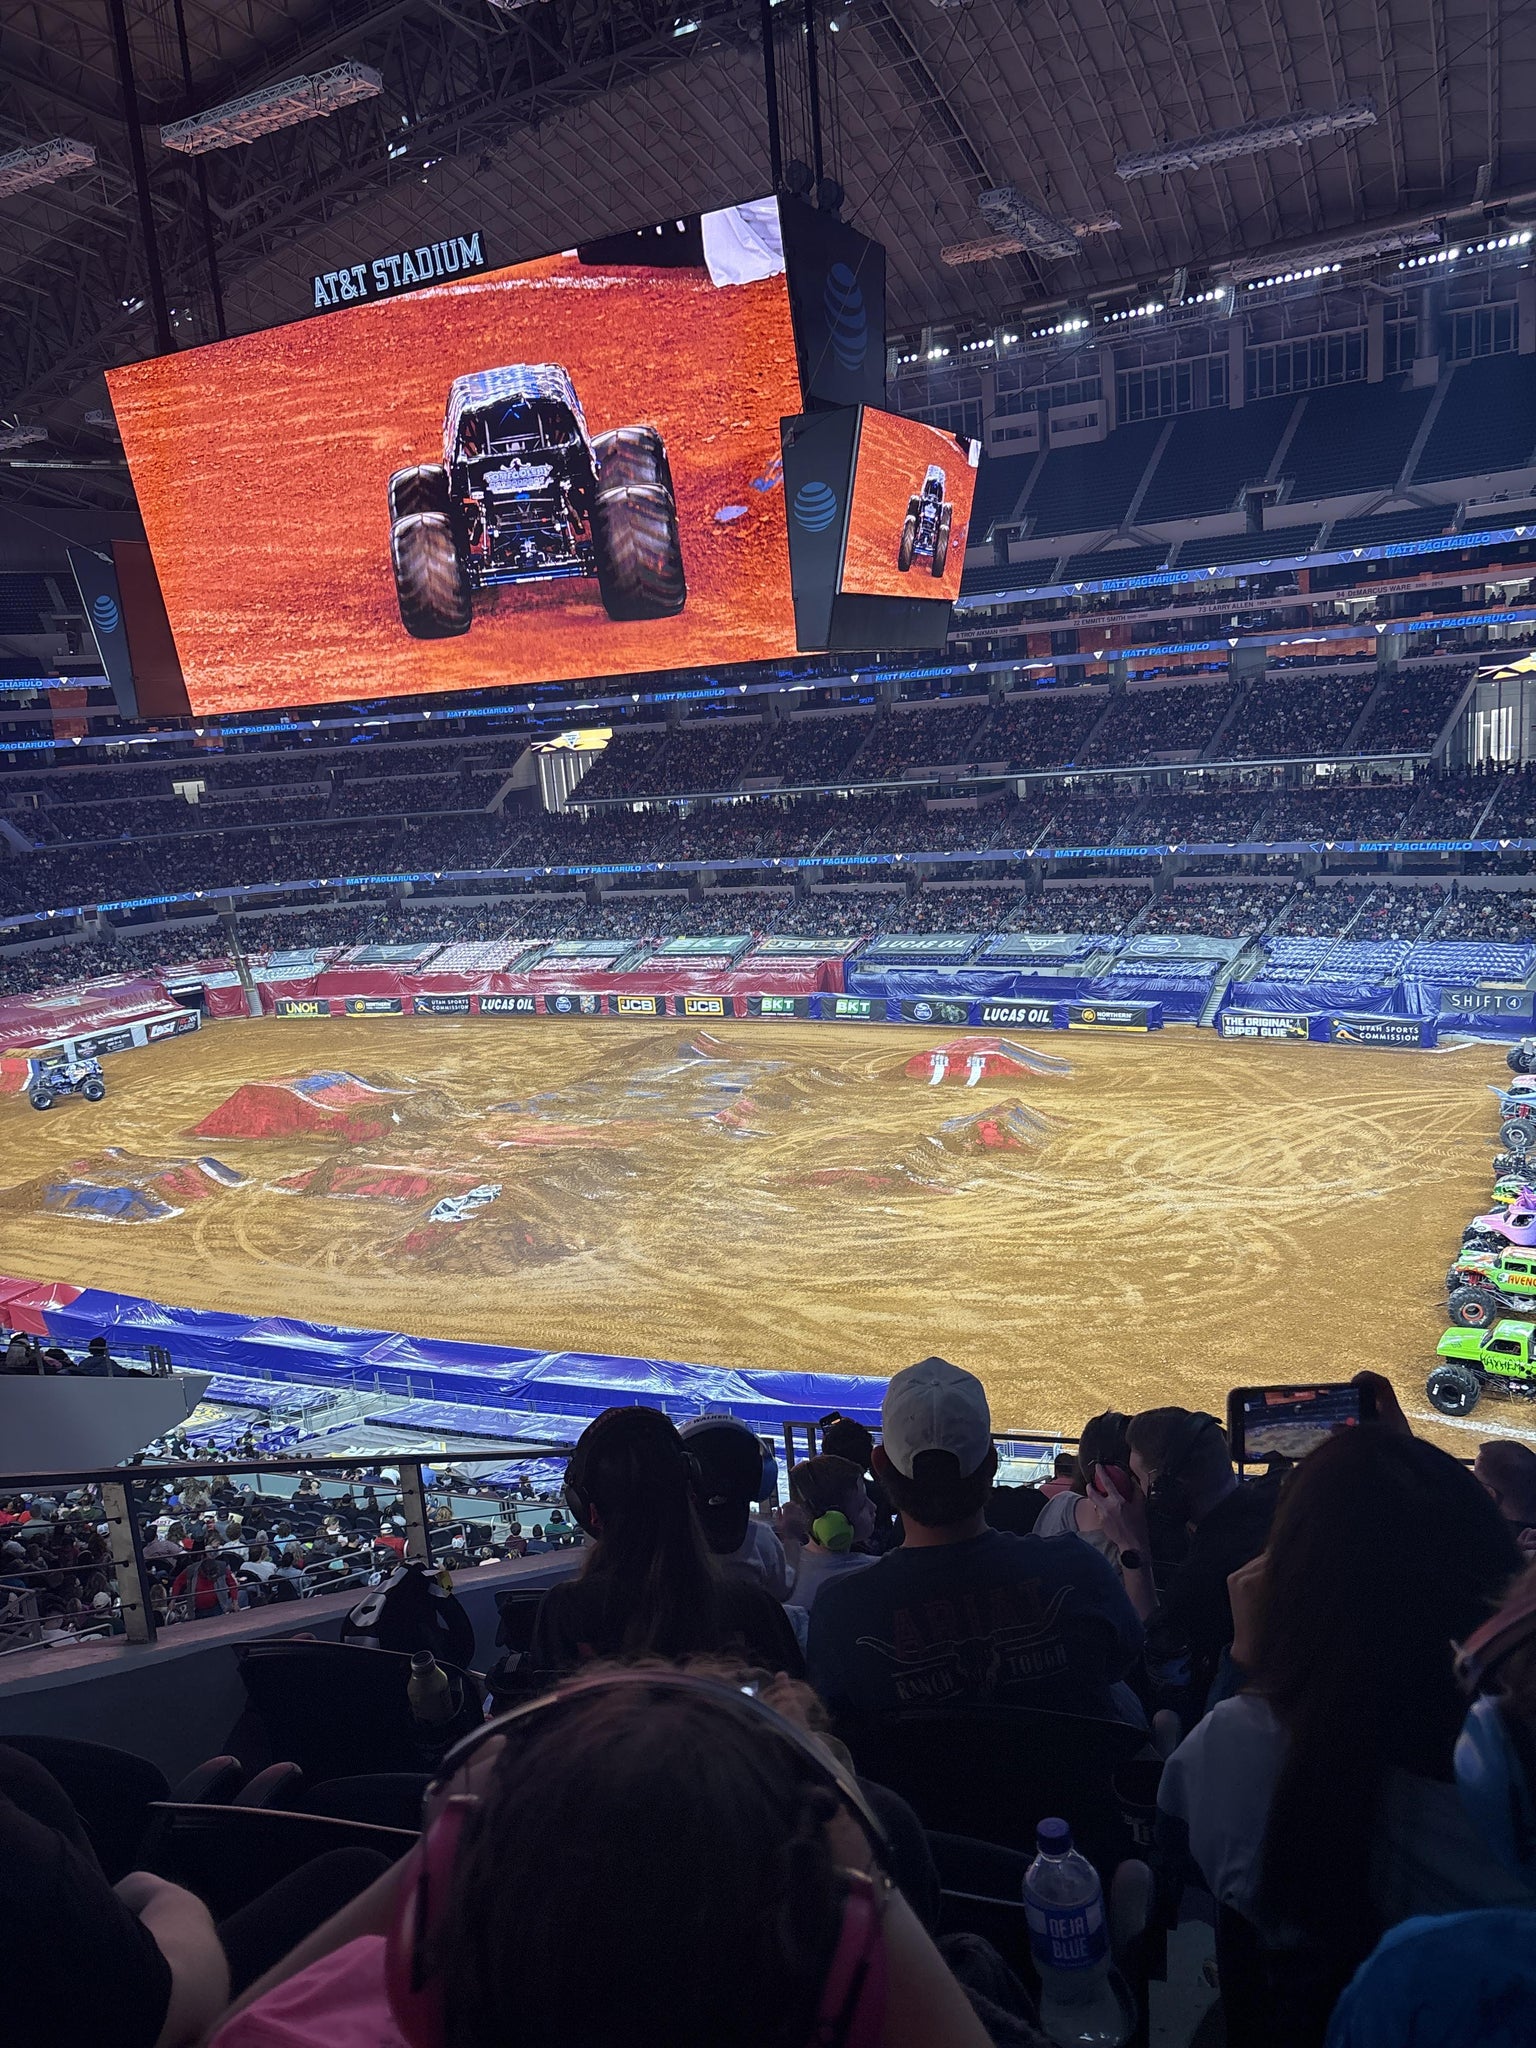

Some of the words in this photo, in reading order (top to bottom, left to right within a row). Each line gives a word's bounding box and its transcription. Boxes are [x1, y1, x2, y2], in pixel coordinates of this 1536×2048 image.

[314, 264, 367, 308] AT&T
[372, 232, 484, 291] STADIUM
[1385, 545, 1416, 556] MATT
[1417, 534, 1490, 551] PAGLIARULO
[1102, 580, 1127, 590] MATT
[1128, 573, 1189, 586] PAGLIARULO
[1390, 584, 1411, 592] WARE
[1209, 604, 1230, 612] LARRY
[1081, 616, 1105, 626] EMMITT
[1106, 614, 1126, 623] SMITH
[1409, 621, 1440, 631] MATT
[1441, 613, 1516, 628] PAGLIARULO
[1122, 648, 1147, 658] MATT
[1149, 643, 1209, 656] PAGLIARULO
[876, 673, 898, 682] MATT
[899, 668, 952, 679] PAGLIARULO
[654, 694, 675, 702] MATT
[676, 689, 725, 699] PAGLIARULO
[447, 710, 467, 718] MATT
[468, 706, 514, 716] PAGLIARULO
[221, 728, 244, 736] MATT
[245, 724, 297, 734] PAGLIARULO
[1054, 849, 1082, 858] MATT
[1083, 848, 1148, 856] PAGLIARULO
[1360, 843, 1392, 852] MATT
[1394, 842, 1473, 850] PAGLIARULO
[798, 858, 821, 866] MATT
[822, 856, 878, 865] PAGLIARULO
[591, 866, 642, 874] PAGLIARULO
[370, 874, 420, 884] PAGLIARULO
[121, 896, 178, 909] PAGLIARULO
[877, 940, 938, 948] LUCAS
[938, 940, 968, 948] OIL
[482, 998, 515, 1010] LUCAS
[516, 998, 534, 1010] OIL
[621, 1000, 653, 1011] JCB
[688, 1001, 720, 1012] JCB
[761, 998, 794, 1011] BKT
[836, 1000, 870, 1013] BKT
[1452, 994, 1503, 1008] SHIFT
[286, 1002, 318, 1014] UNOH
[983, 1008, 1026, 1022] LUCAS
[1028, 1008, 1051, 1022] OIL
[1224, 1017, 1244, 1026] THE
[1246, 1018, 1291, 1028] ORIGINAL
[1224, 1026, 1258, 1036] SUPER
[1260, 1028, 1288, 1037] GLUE
[1385, 1026, 1419, 1034] SPORTS
[1359, 1032, 1418, 1041] COMMISSION
[895, 1669, 955, 1700] RANCH
[1006, 1643, 1068, 1676] TOUGH
[1049, 1916, 1085, 1939] DEJA
[1052, 1938, 1088, 1960] BLUE
